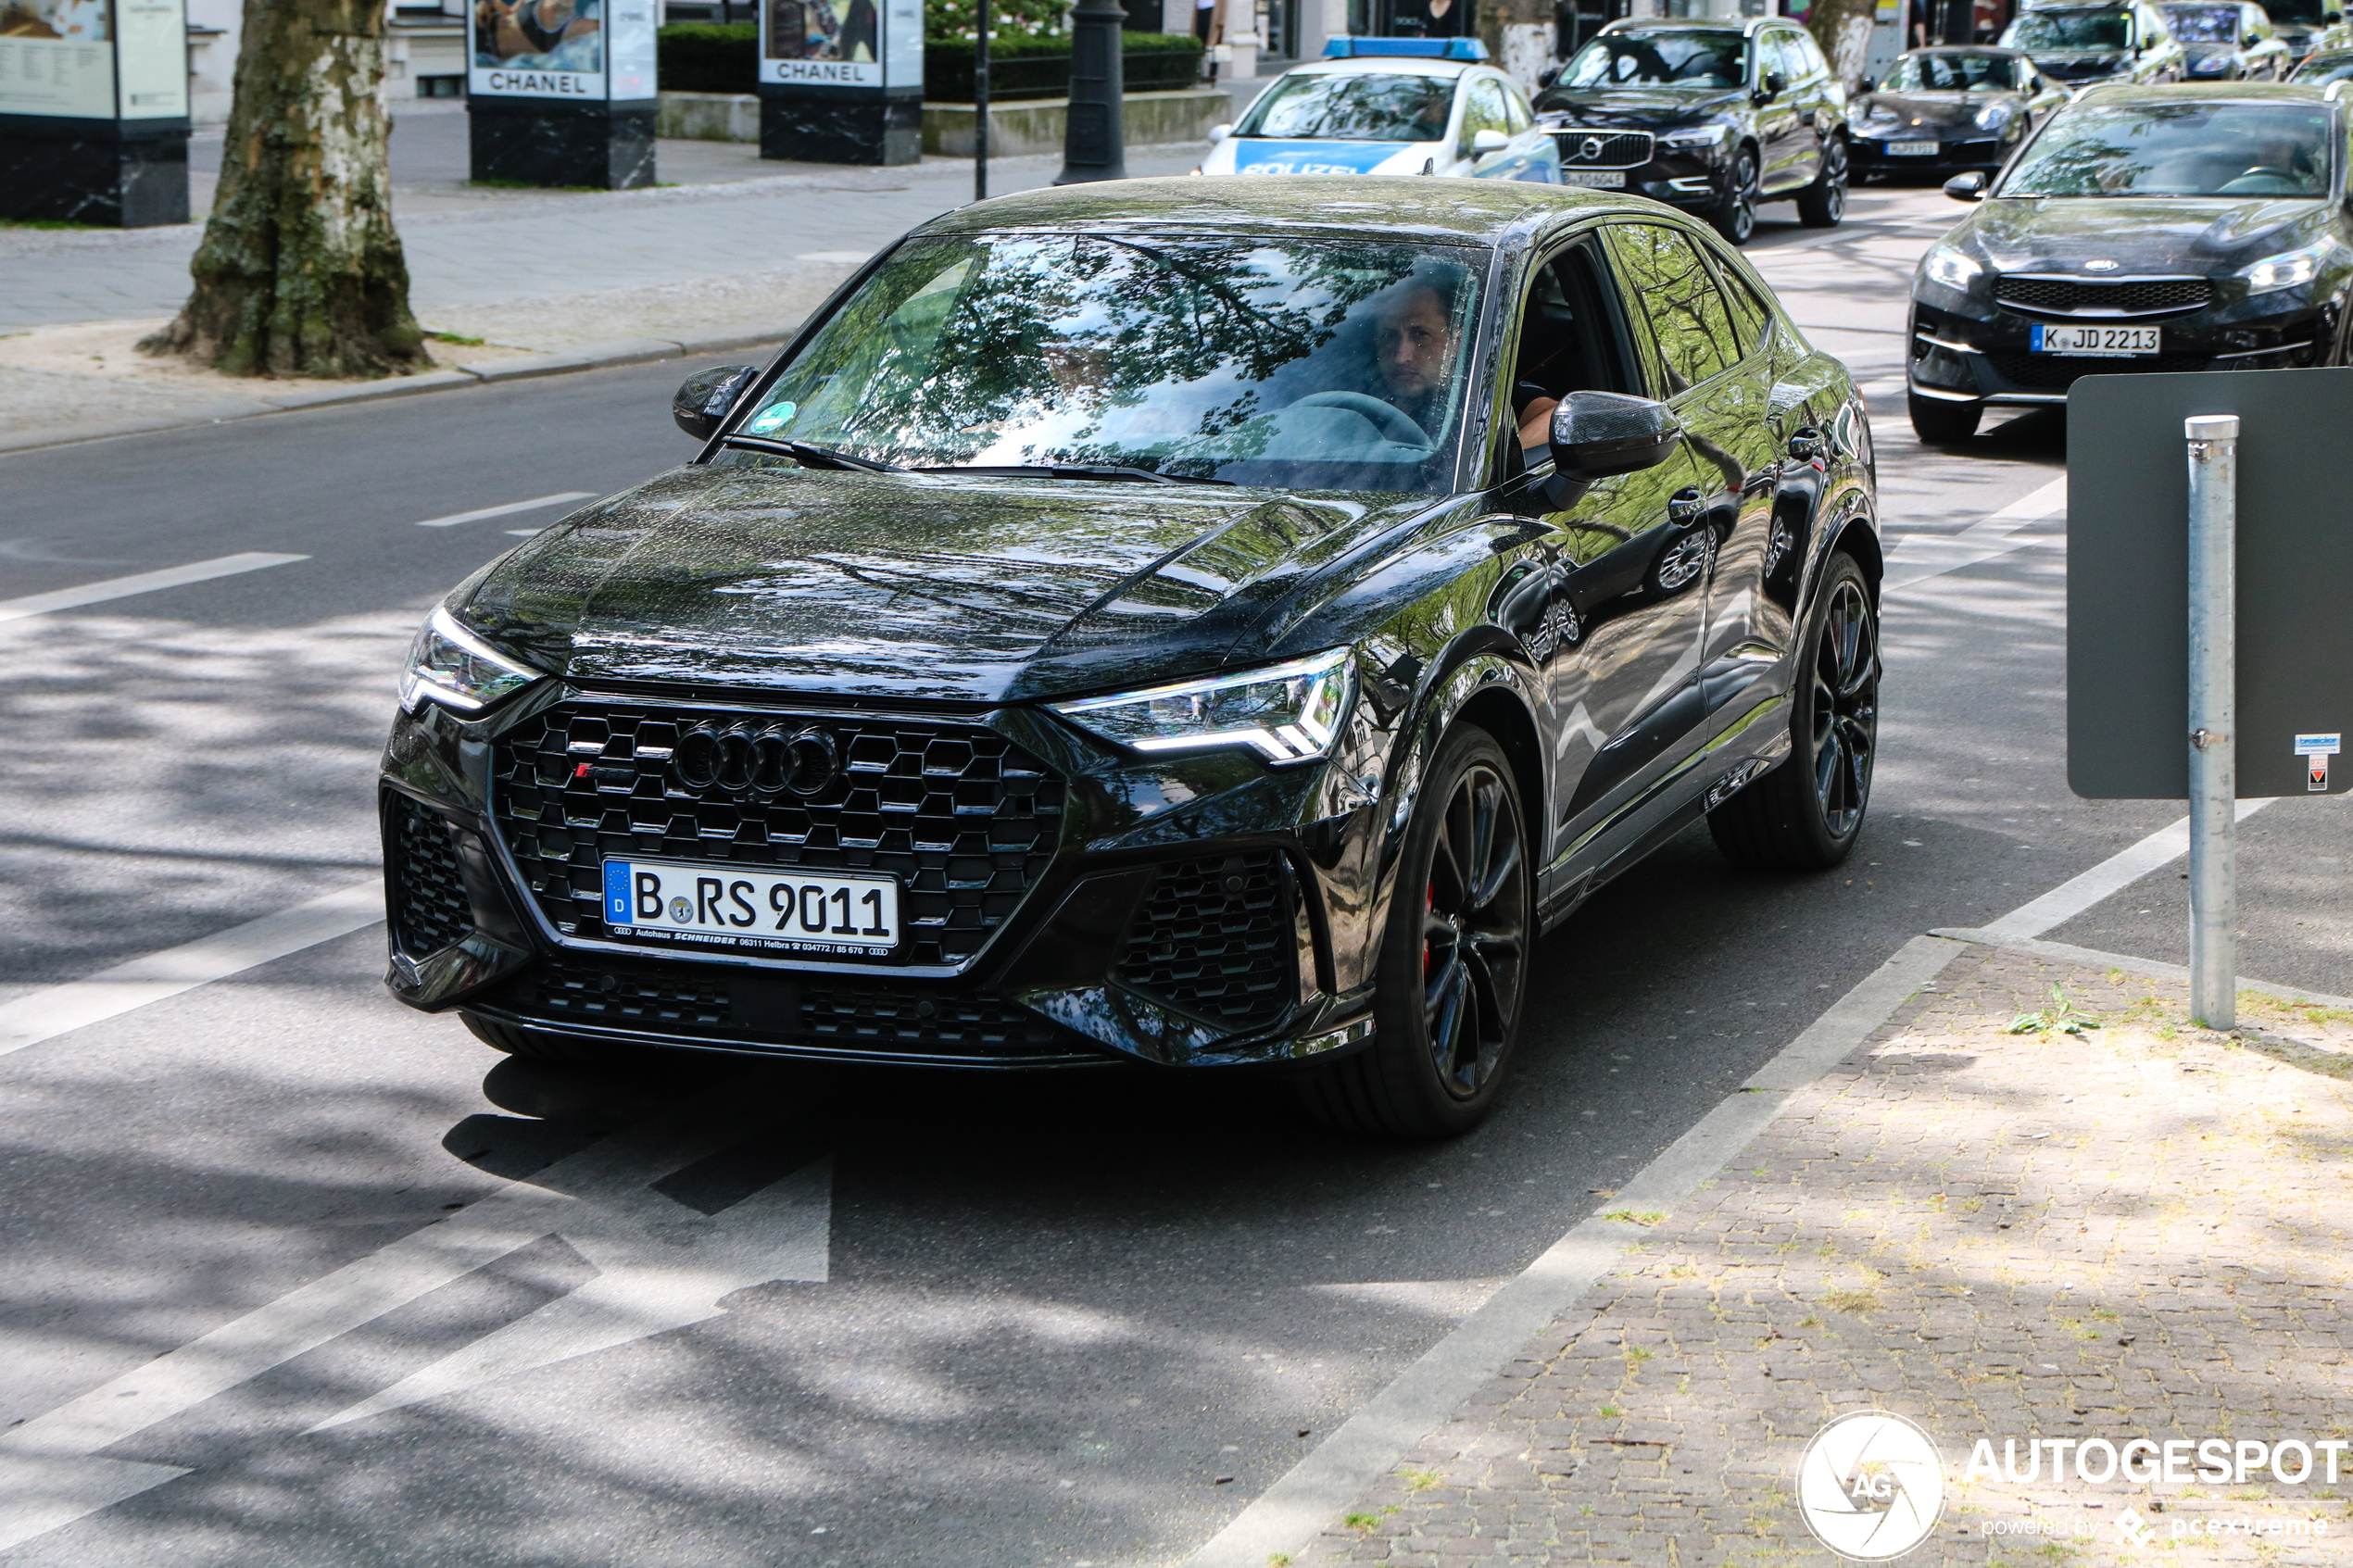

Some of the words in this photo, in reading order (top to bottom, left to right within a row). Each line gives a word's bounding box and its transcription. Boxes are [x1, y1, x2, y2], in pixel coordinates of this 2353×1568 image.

[776, 63, 864, 82] CHANEL
[489, 73, 586, 94] CHANEL
[2045, 329, 2058, 348] K
[2073, 330, 2099, 348] JD
[2105, 331, 2157, 349] 2213
[614, 898, 624, 912] D
[635, 872, 663, 919] B
[697, 877, 756, 927] RS
[769, 883, 889, 936] 9011
[635, 928, 671, 939] Autohaus
[674, 933, 737, 946] SCHNEIDER
[739, 938, 762, 947] 06311
[763, 940, 789, 949] Helbra
[802, 943, 830, 953] 034772
[837, 946, 847, 954] 85
[848, 947, 863, 955] 670
